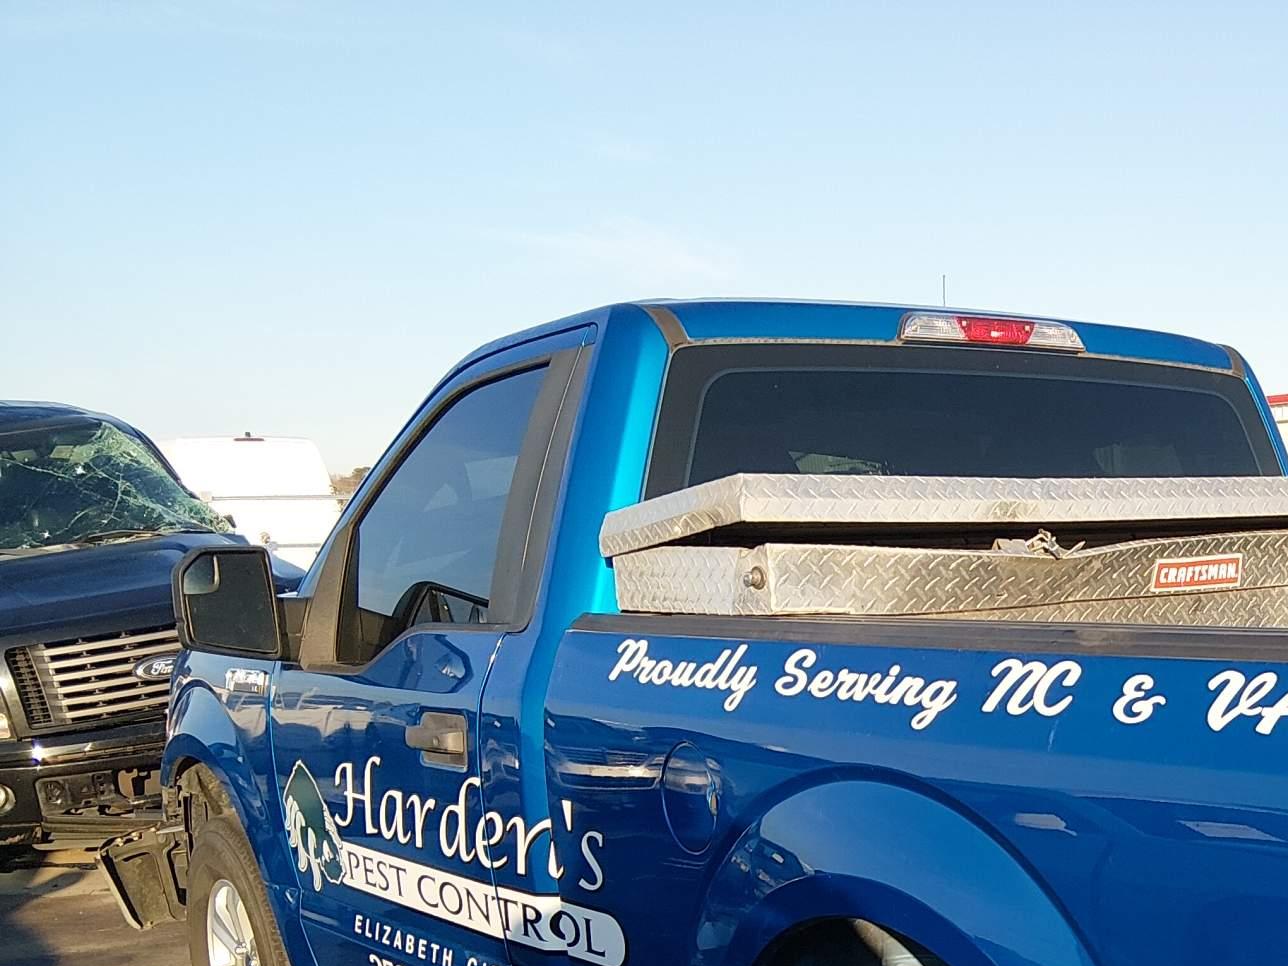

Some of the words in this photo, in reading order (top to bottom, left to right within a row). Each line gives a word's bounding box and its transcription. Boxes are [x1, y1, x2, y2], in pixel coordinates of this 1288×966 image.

[1159, 563, 1238, 584] CRAFTSMAN
[151, 660, 174, 675] For
[608, 639, 758, 712] Proudly
[774, 648, 958, 731] Serving
[981, 658, 1082, 717] NC
[1112, 674, 1167, 724] &
[334, 756, 604, 891] Harden's
[347, 850, 407, 897] PEST
[416, 874, 606, 958] CONTROL
